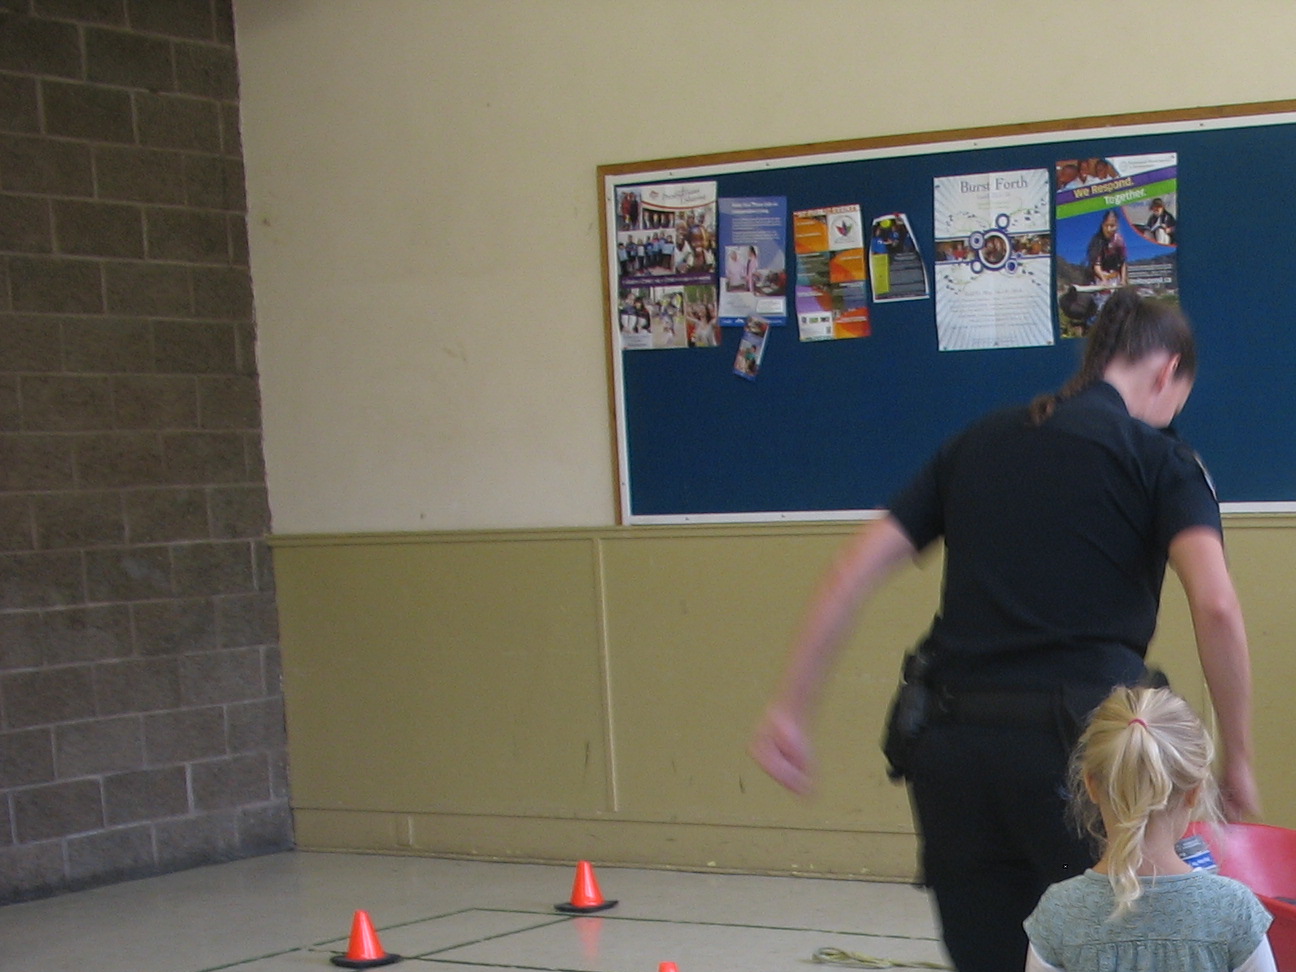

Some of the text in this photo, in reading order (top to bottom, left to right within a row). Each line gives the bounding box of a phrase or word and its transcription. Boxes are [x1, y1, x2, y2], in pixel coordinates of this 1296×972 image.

[960, 175, 1028, 194] Burst Forth
[1073, 177, 1135, 198] We Respond.
[1104, 188, 1147, 205] Together.
